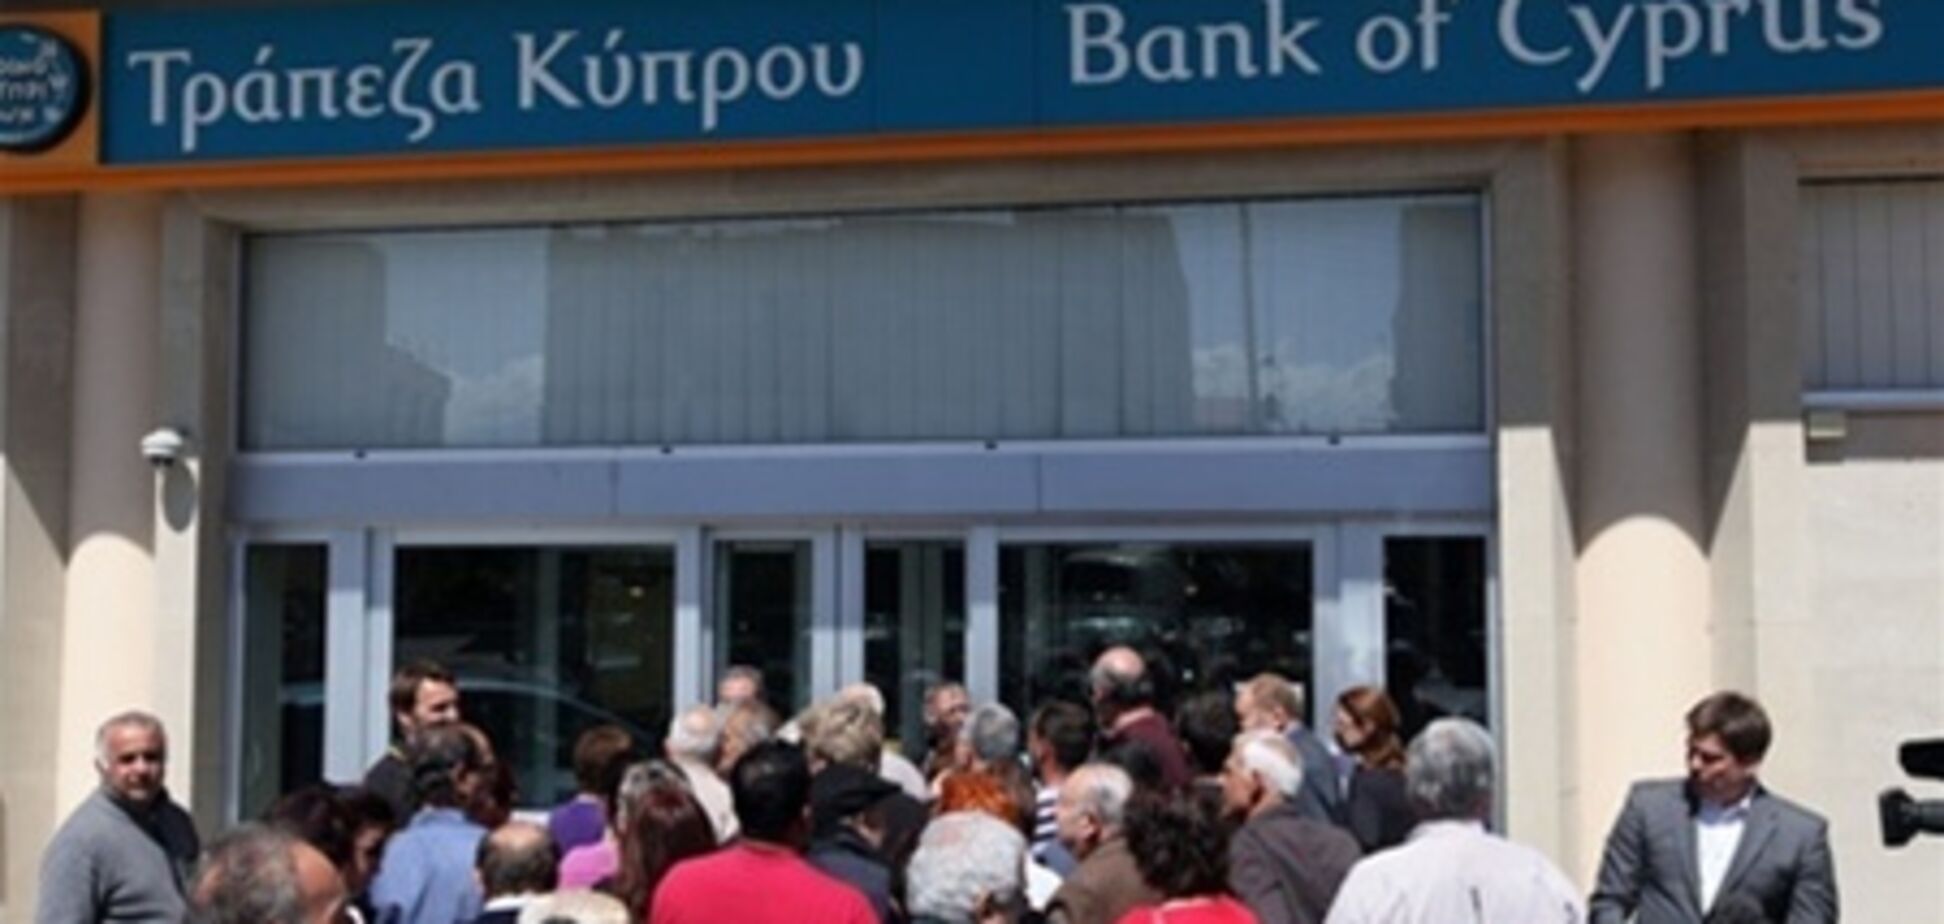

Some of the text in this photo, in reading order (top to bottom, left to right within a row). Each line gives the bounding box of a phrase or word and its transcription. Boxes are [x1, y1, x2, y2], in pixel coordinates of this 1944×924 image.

[128, 28, 863, 151] Τράπεζα Κύπρου
[1067, 0, 1883, 92] Bank of Cyprus
